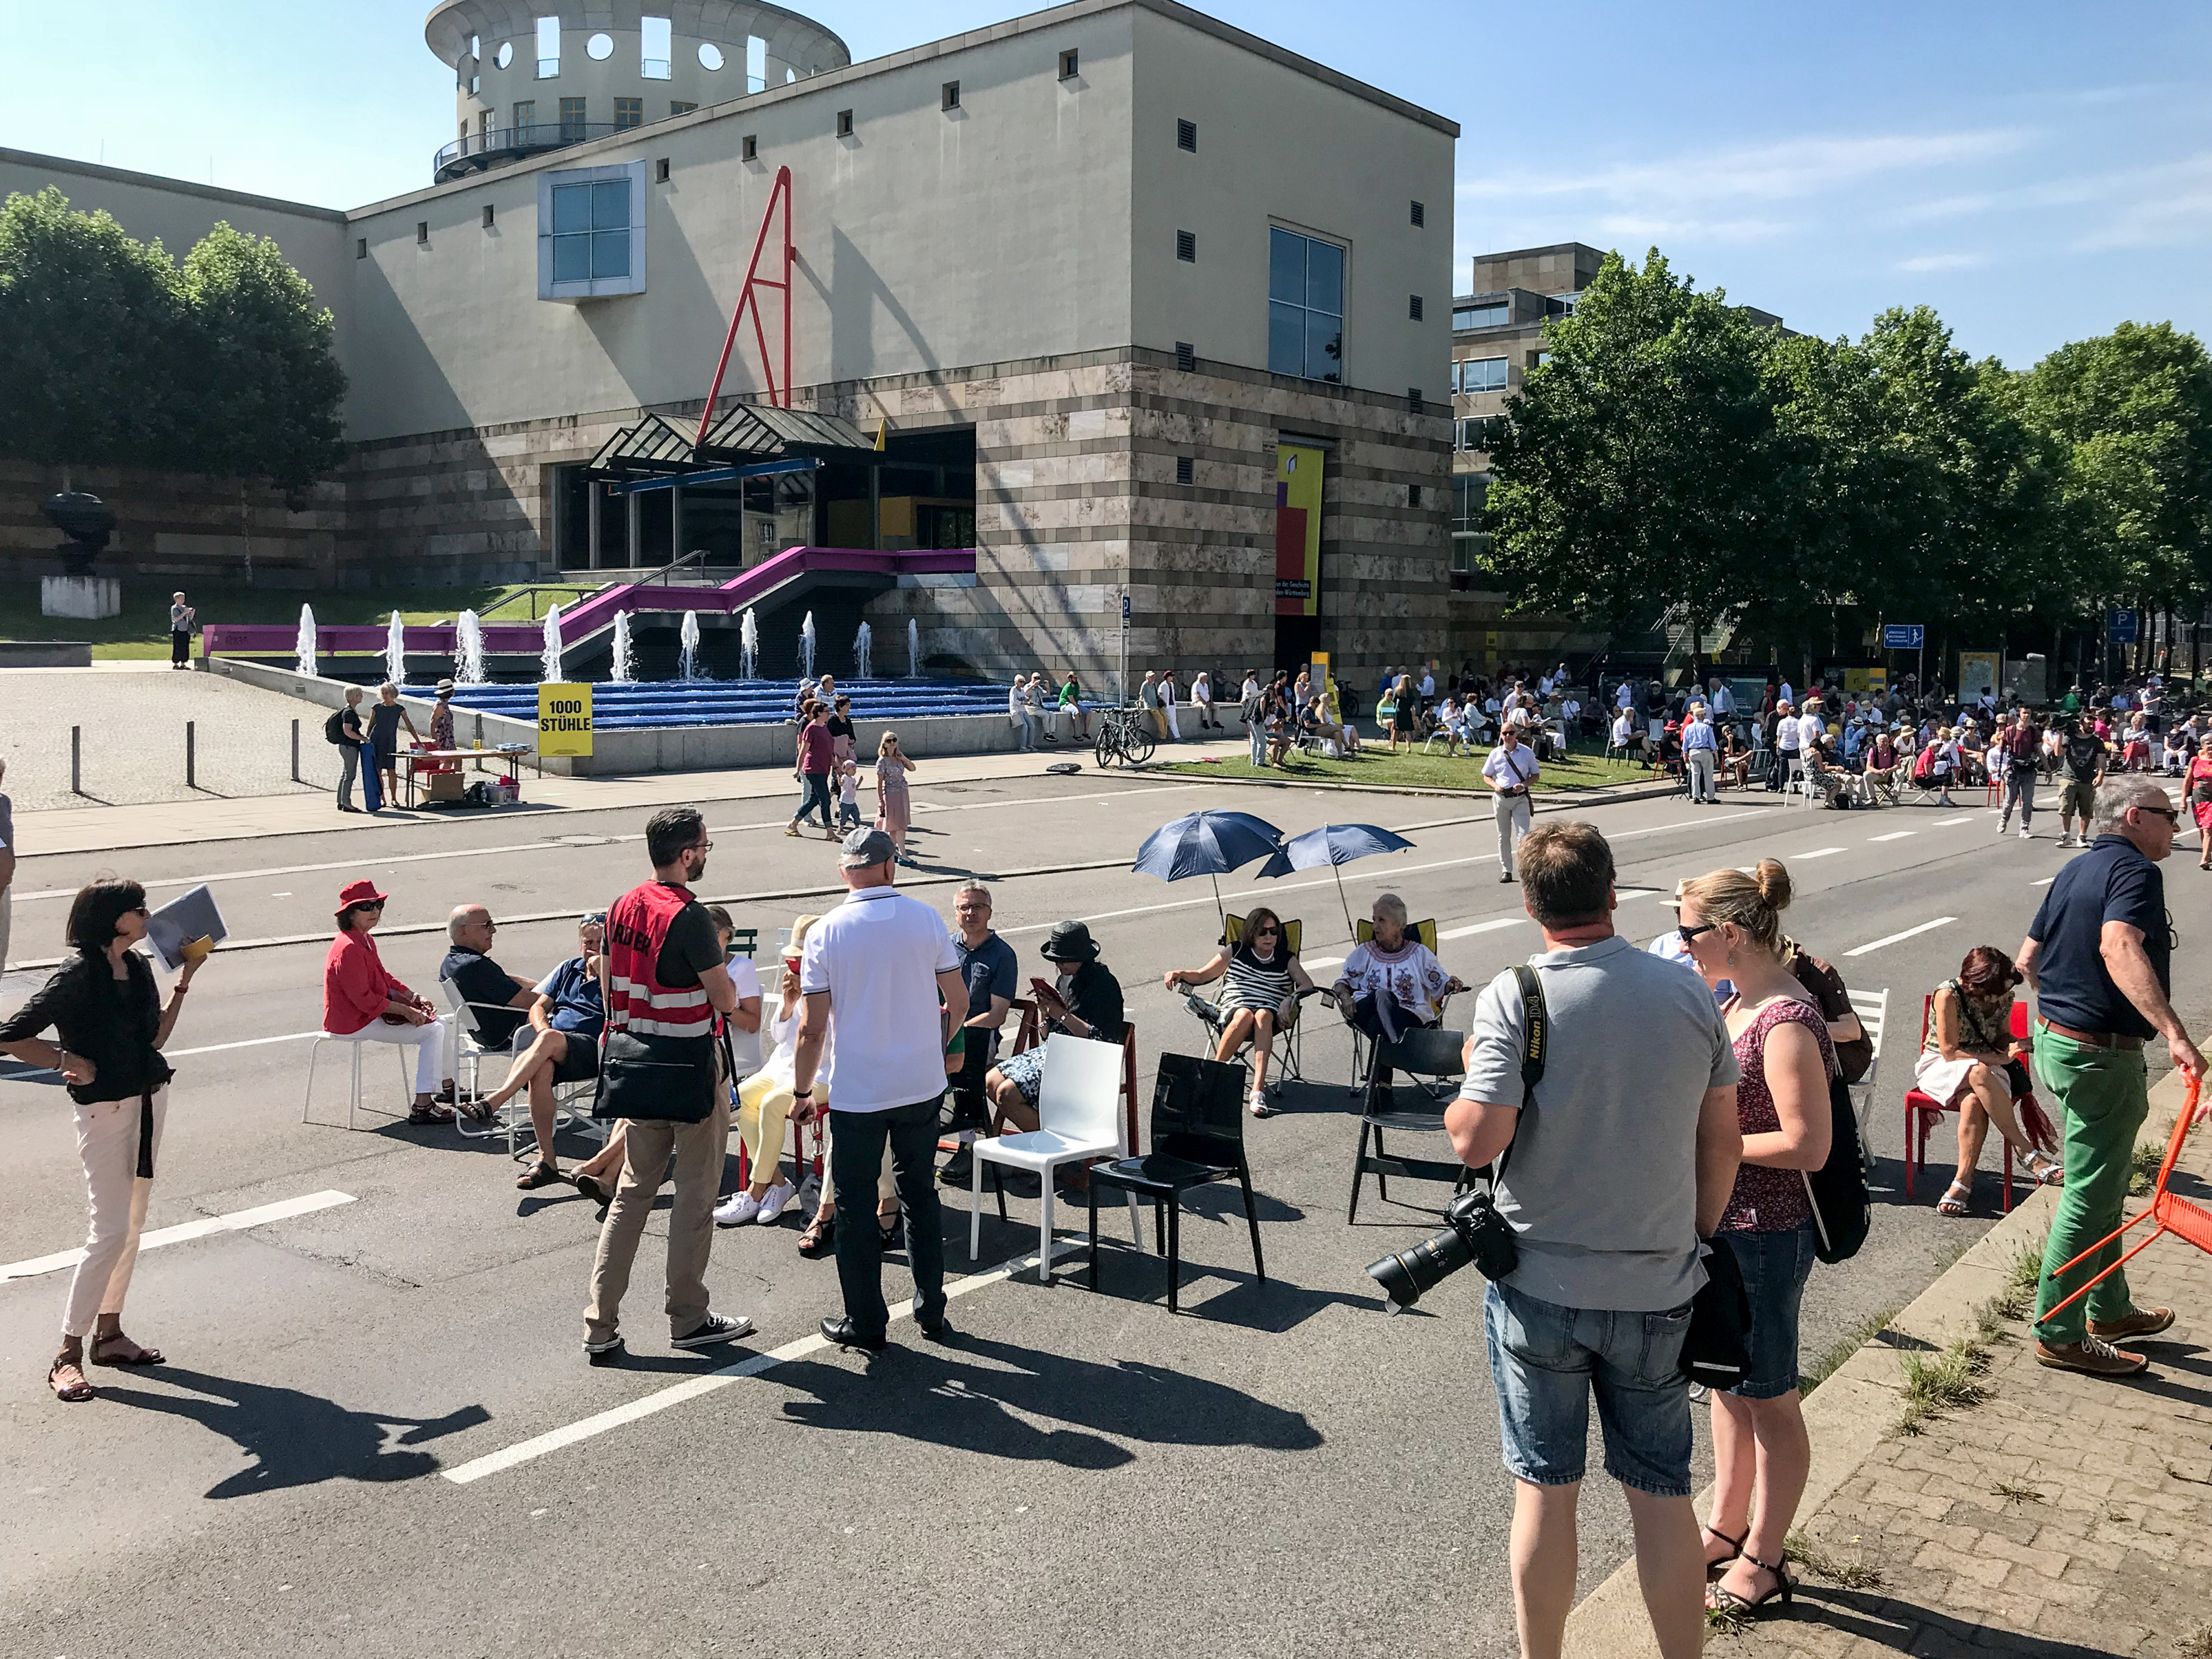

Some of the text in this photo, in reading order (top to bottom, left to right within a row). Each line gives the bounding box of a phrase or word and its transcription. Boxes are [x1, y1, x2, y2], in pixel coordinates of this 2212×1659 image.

[1124, 599, 1129, 615] P
[2118, 613, 2127, 625] P
[549, 700, 582, 714] 1000
[541, 716, 591, 732] STÜHLE
[1527, 995, 1541, 1059] Nikon D4
